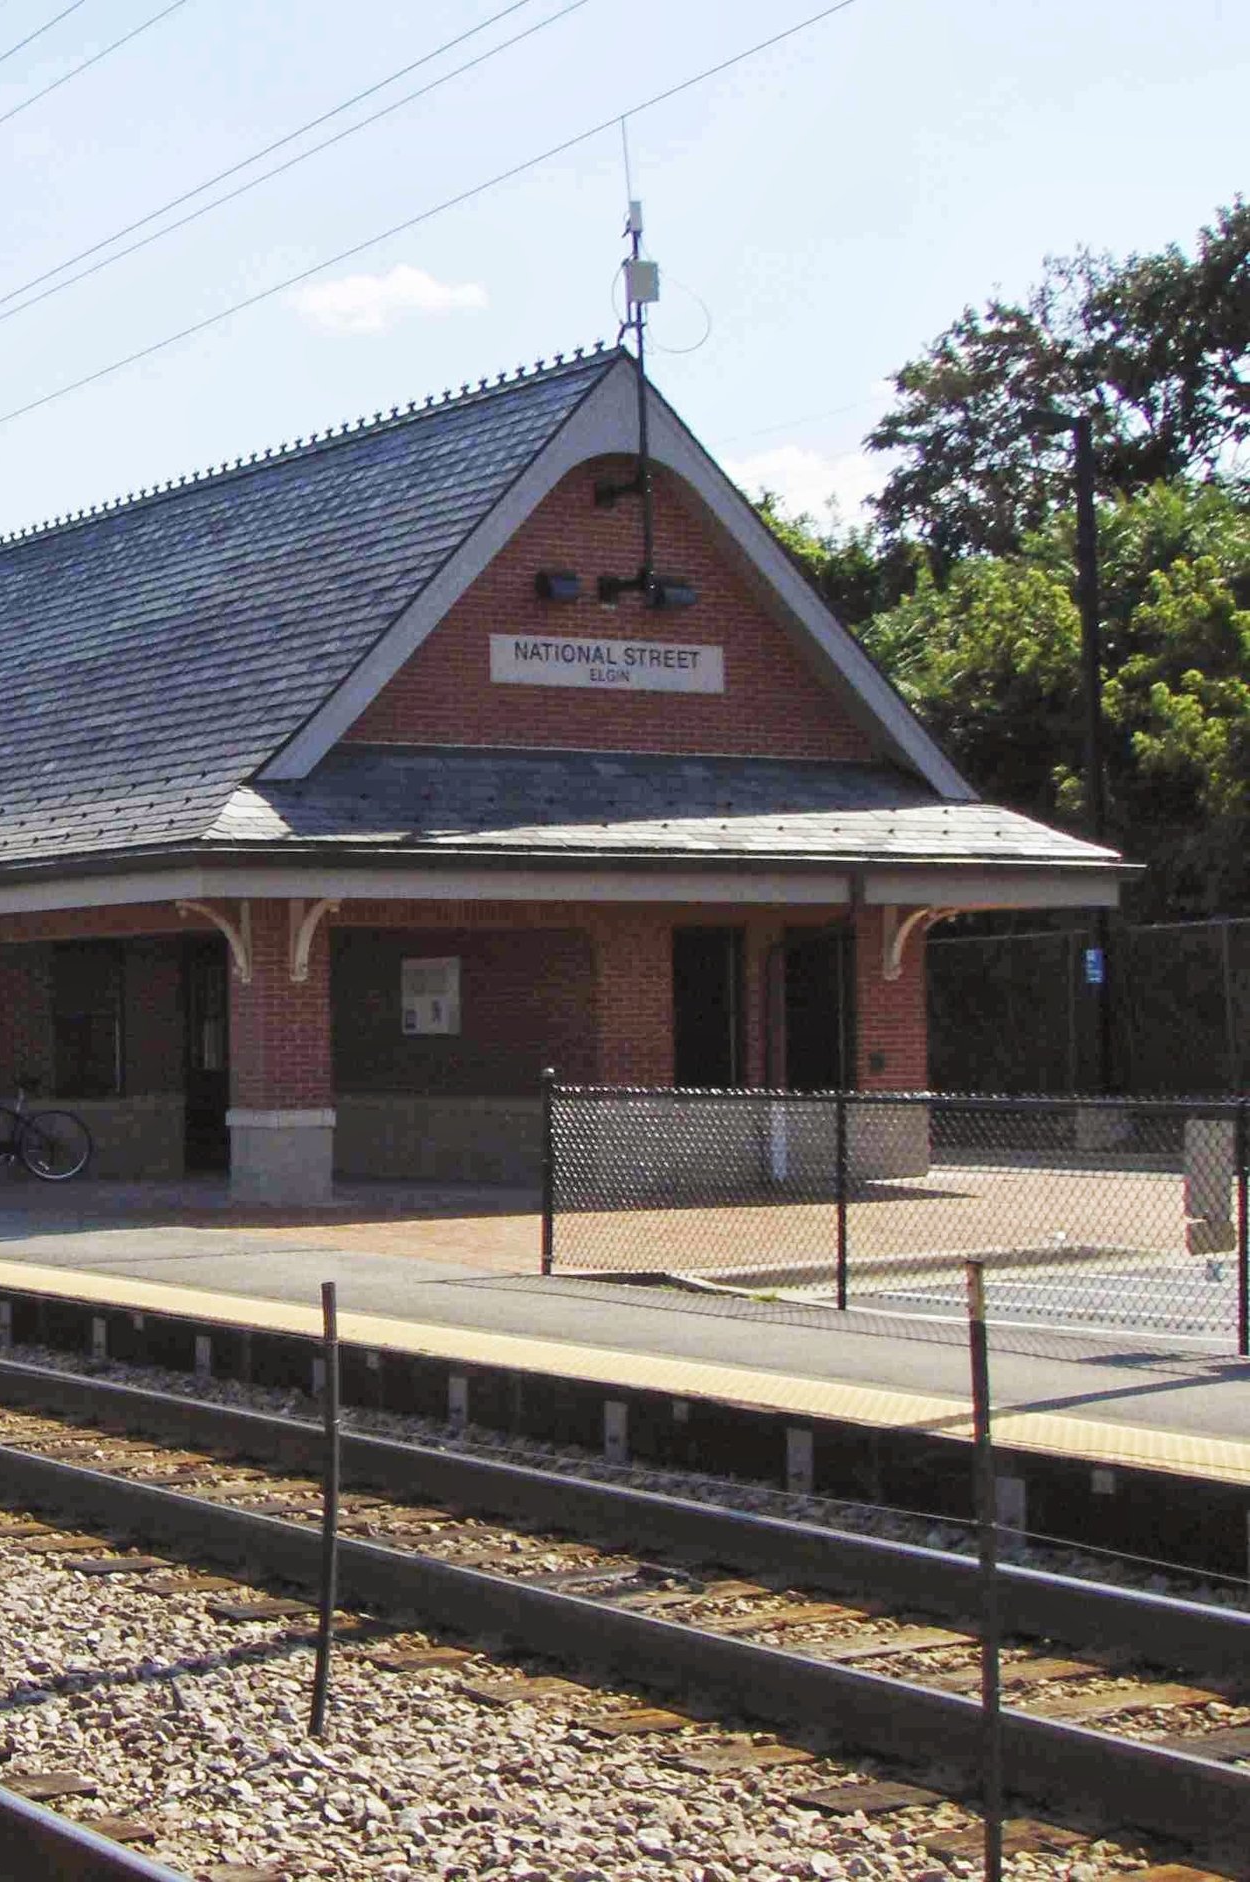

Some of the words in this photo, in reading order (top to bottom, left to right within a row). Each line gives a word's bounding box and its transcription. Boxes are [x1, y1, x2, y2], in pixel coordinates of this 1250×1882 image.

[514, 641, 617, 665] NATIONAL
[624, 647, 700, 669] STREET
[589, 668, 630, 682] ELGIN
